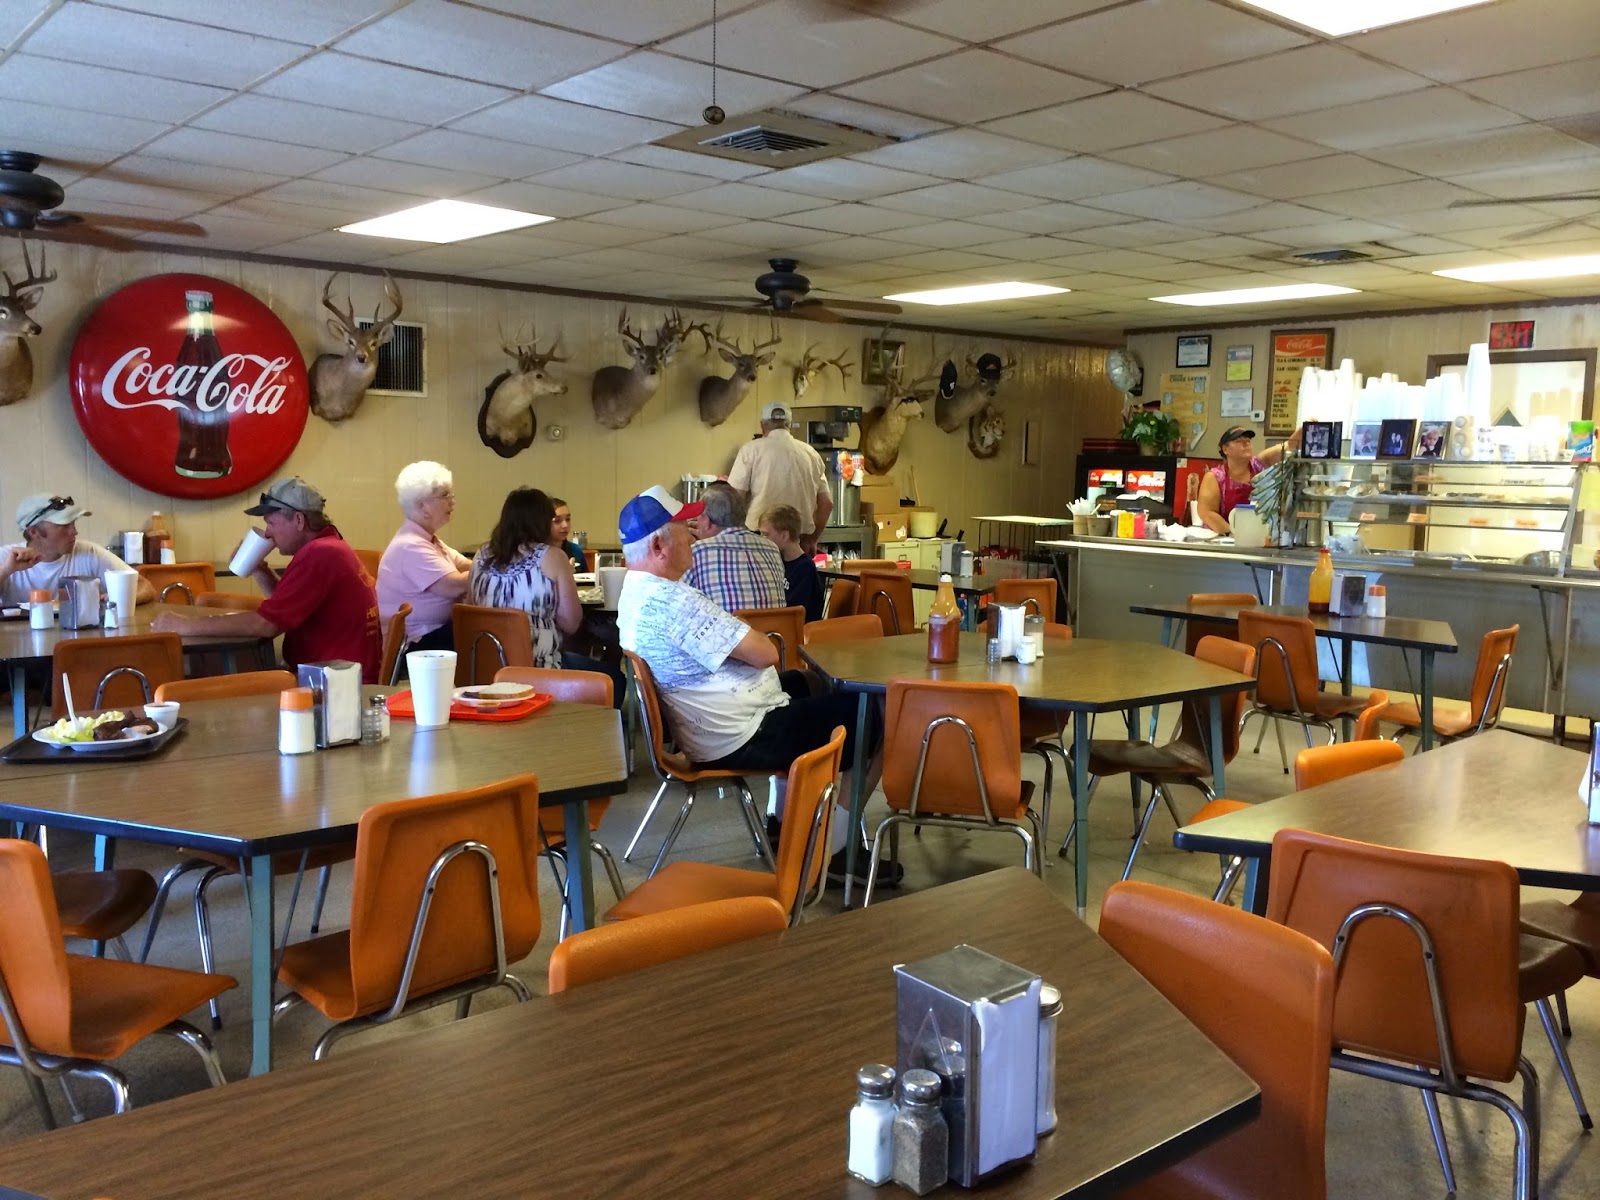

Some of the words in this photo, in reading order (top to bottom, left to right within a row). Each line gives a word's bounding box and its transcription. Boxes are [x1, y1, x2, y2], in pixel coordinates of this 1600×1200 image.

[1491, 321, 1533, 349] EXIT
[101, 346, 293, 415] Coca-Cola
[694, 617, 718, 641] Texas
